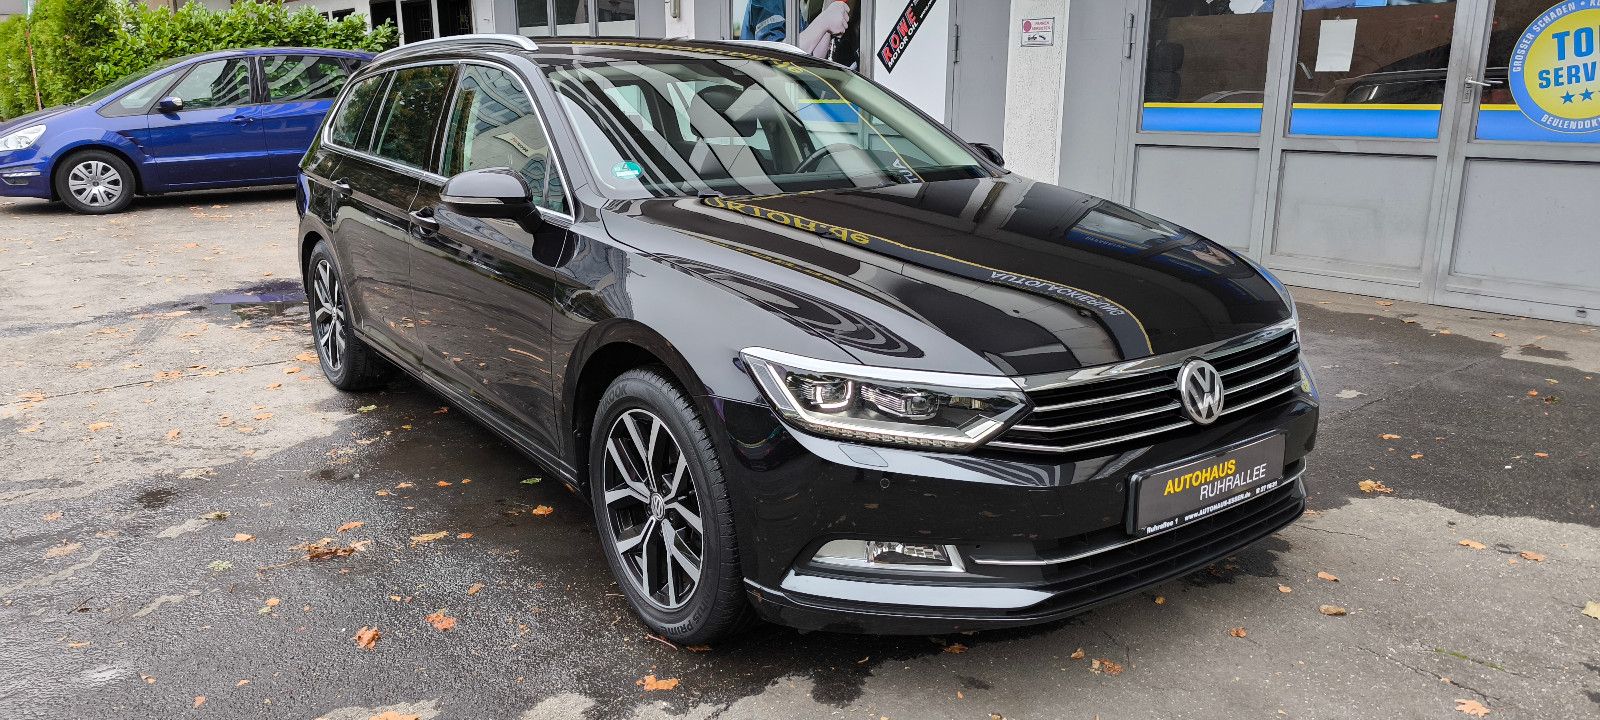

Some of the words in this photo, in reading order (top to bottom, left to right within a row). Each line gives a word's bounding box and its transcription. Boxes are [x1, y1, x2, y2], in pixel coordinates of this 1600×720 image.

[881, 5, 917, 65] ROWE
[887, 35, 909, 68] MOTOR
[907, 21, 919, 36] OIL
[1512, 33, 1535, 73] GROSSER
[1532, 2, 1577, 33] SCHADEN
[1551, 25, 1600, 61] TO
[1163, 459, 1237, 496] AUTOHAUS
[1199, 462, 1268, 501] RUHRALLEE
